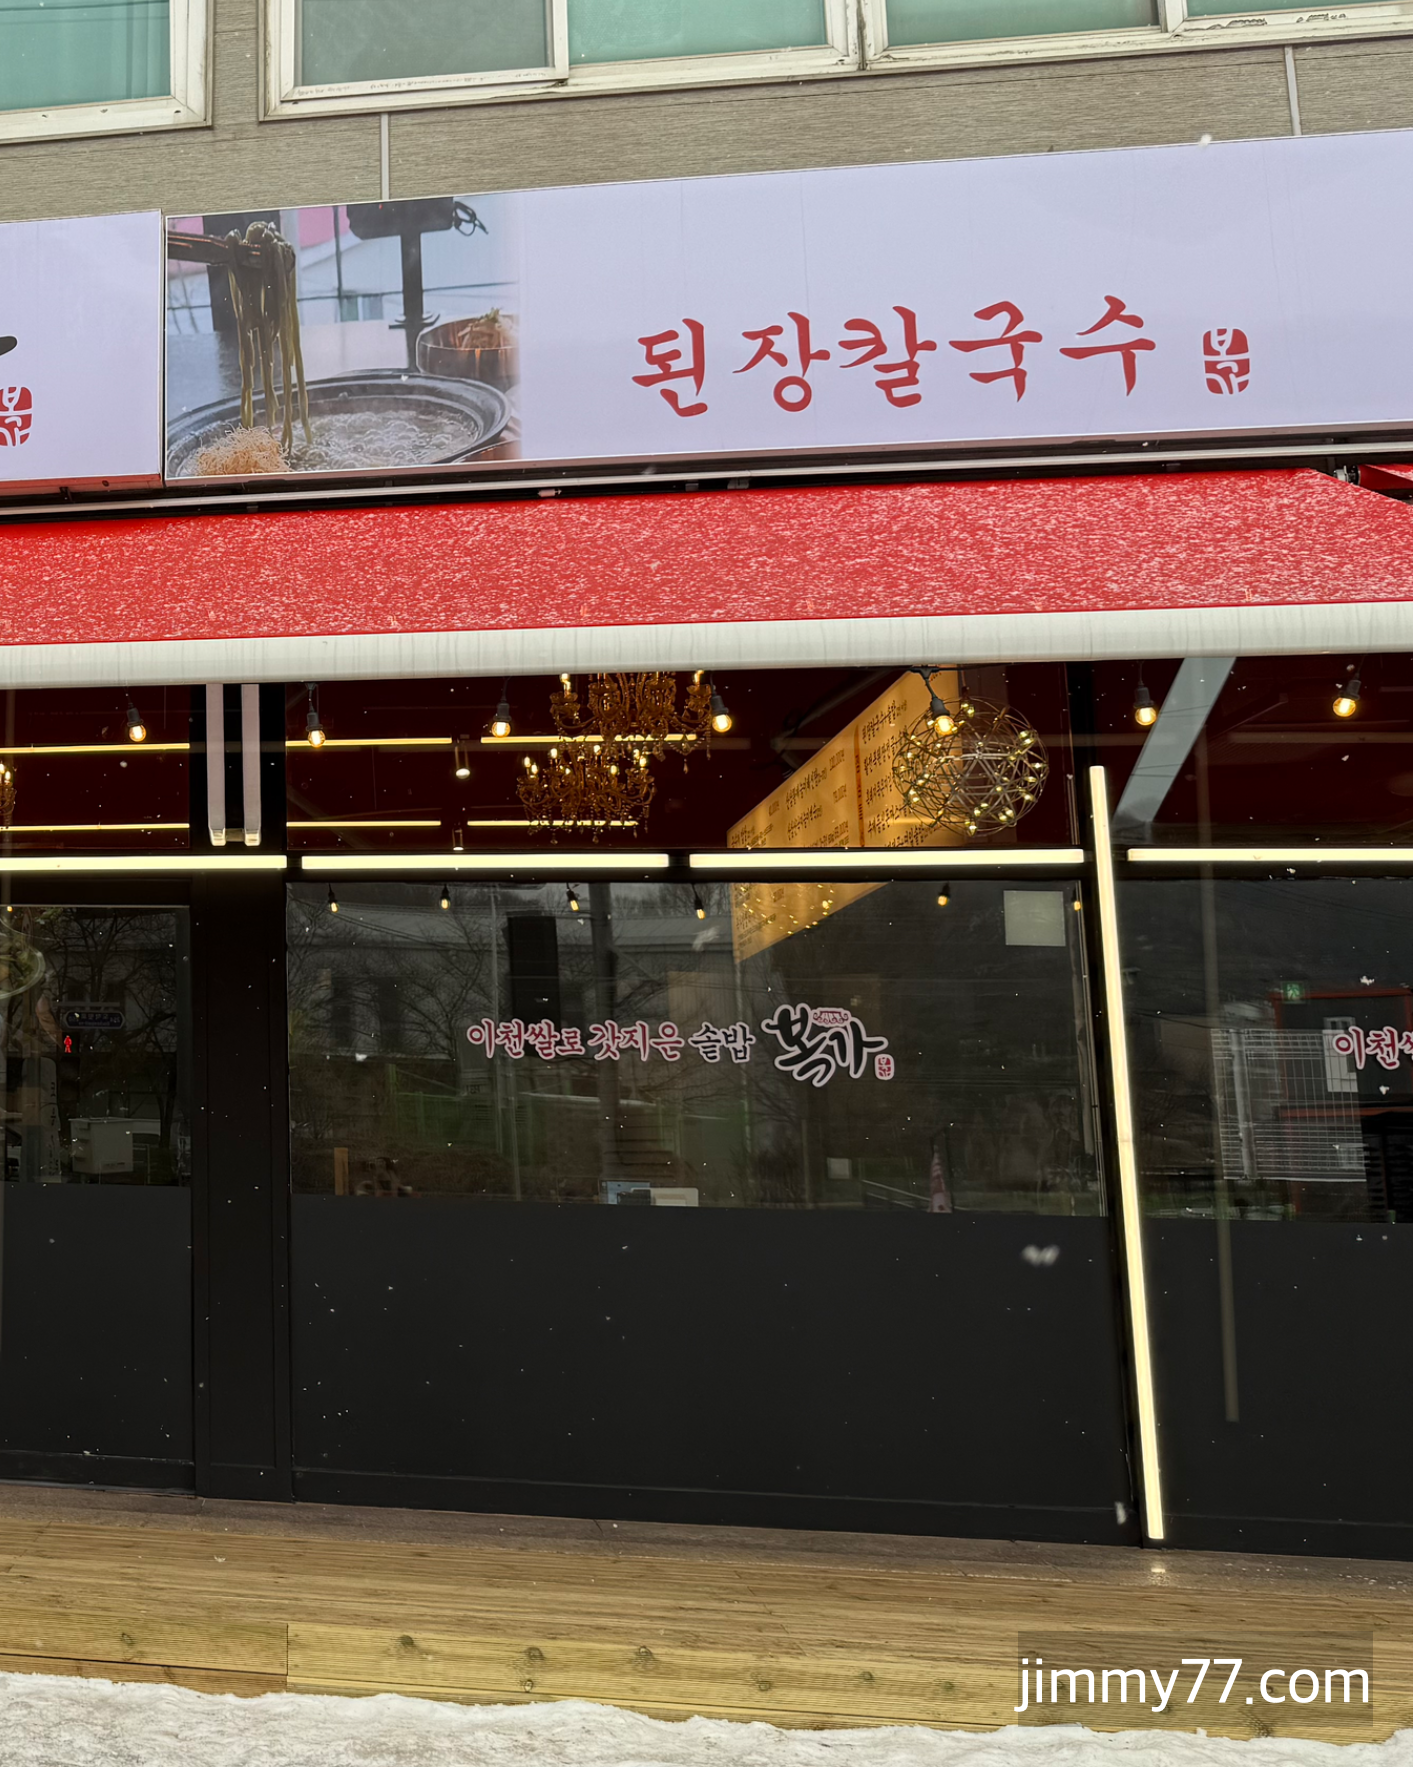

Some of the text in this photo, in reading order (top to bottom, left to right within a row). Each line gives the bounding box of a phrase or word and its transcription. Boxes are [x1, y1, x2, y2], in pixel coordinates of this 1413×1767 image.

[632, 295, 1157, 418] 된장칼국수
[466, 1002, 889, 1088] 이천쌀로 갓지은 솥밥 복가
